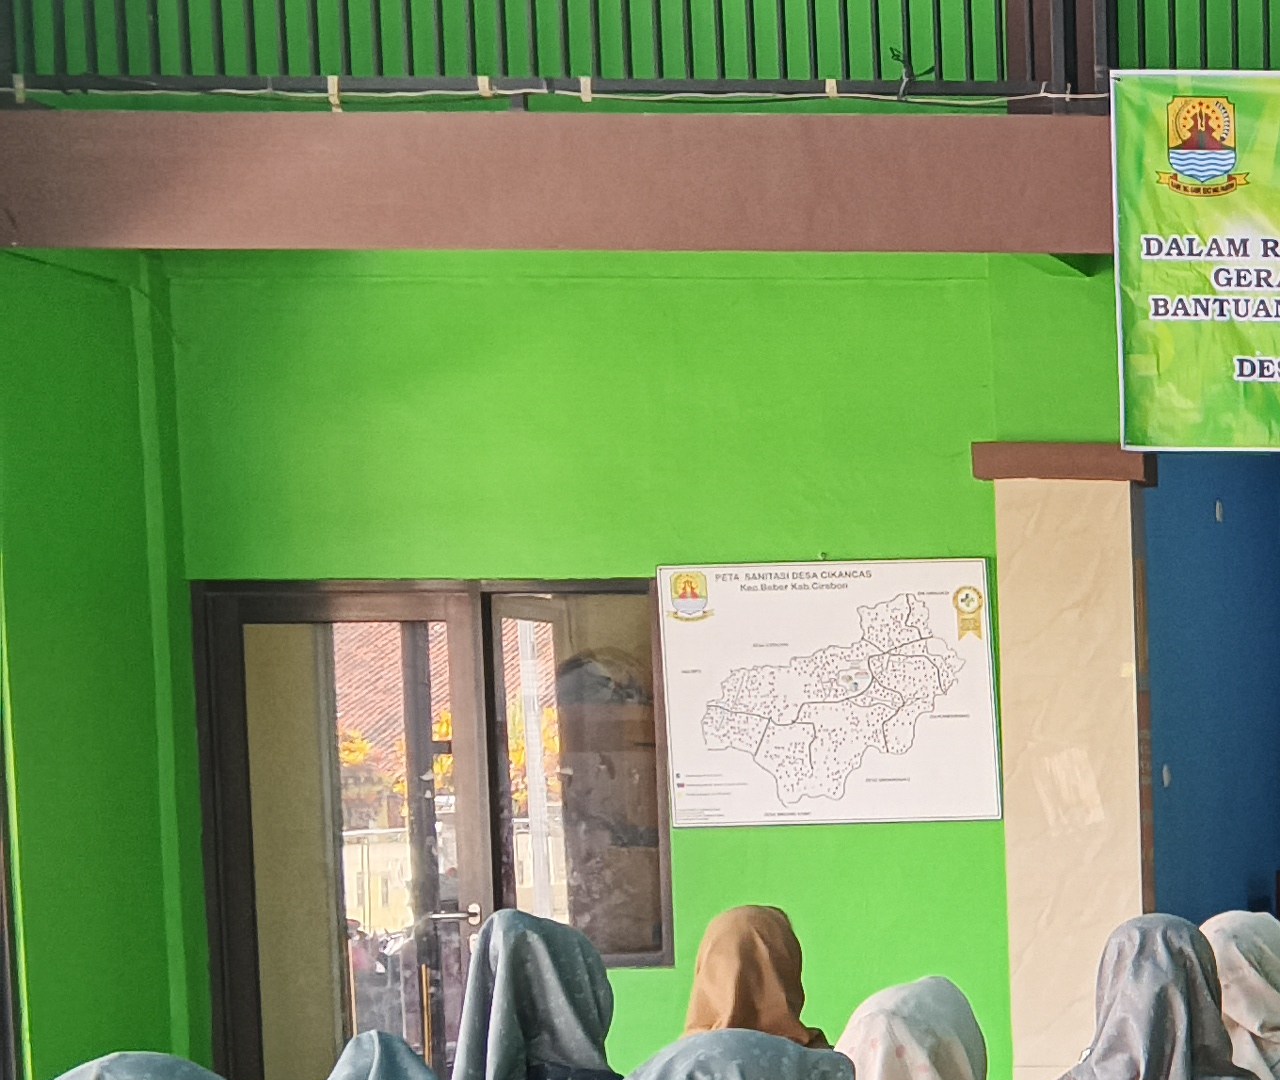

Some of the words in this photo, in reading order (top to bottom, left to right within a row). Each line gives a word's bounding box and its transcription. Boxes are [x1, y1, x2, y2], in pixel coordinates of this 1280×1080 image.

[1144, 237, 1250, 258] DALAM
[792, 571, 818, 580] DESA
[820, 570, 872, 580] CIKANCAS
